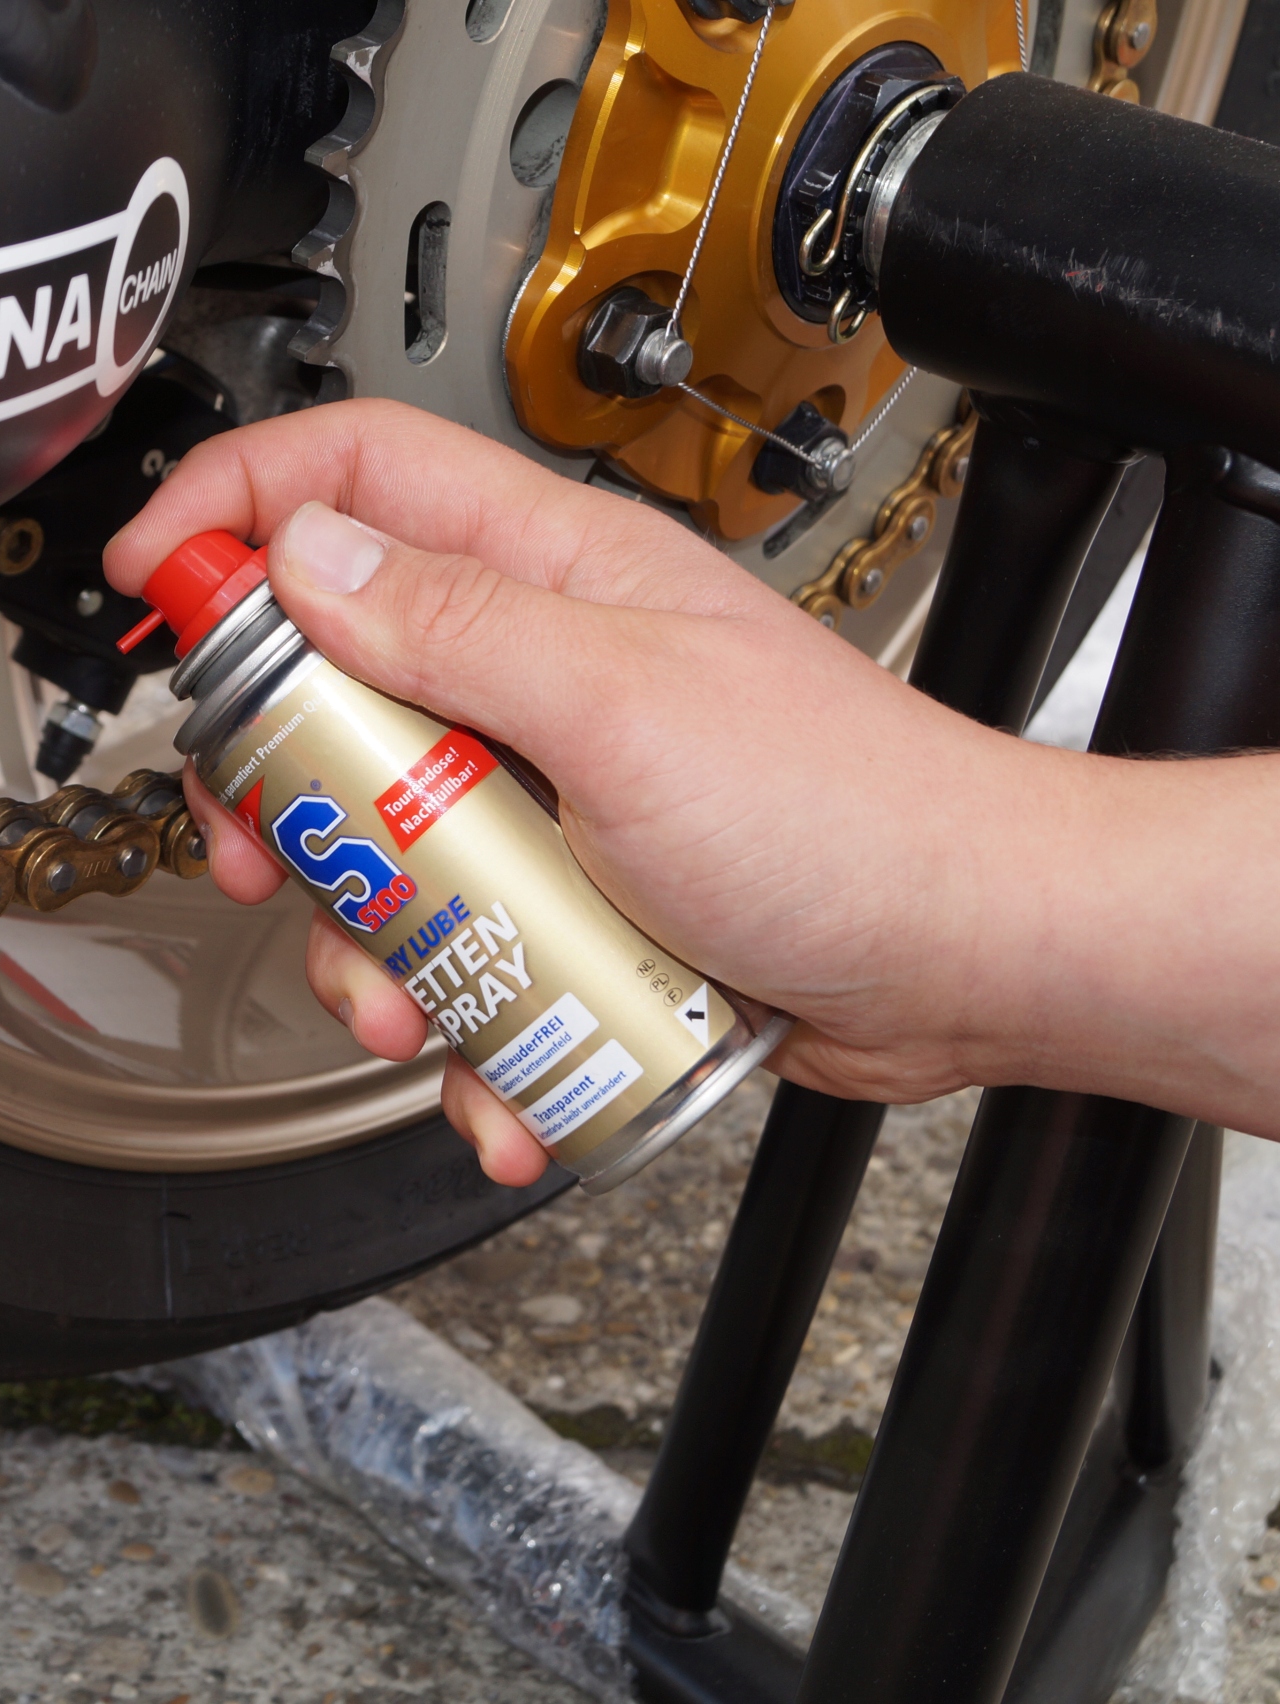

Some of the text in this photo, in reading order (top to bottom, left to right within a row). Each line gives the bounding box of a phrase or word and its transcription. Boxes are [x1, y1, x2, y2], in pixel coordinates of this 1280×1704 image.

[119, 248, 178, 314] CHAIN
[224, 712, 305, 799] garantiert Premium
[383, 746, 460, 817] Tourendose!
[400, 760, 479, 835] Nachfüllbar!
[356, 874, 418, 932] S100
[408, 894, 471, 960] LUBE
[402, 900, 519, 1014] ETTEN
[637, 961, 656, 976] NL
[651, 977, 668, 991] PL
[667, 990, 678, 1003] F
[484, 1015, 565, 1083] AbschleuderFREI
[520, 1031, 573, 1078] Kettenumfeld
[532, 1074, 596, 1125] Transparent
[563, 1107, 583, 1126] bleibt
[580, 1070, 627, 1111] unverändert
